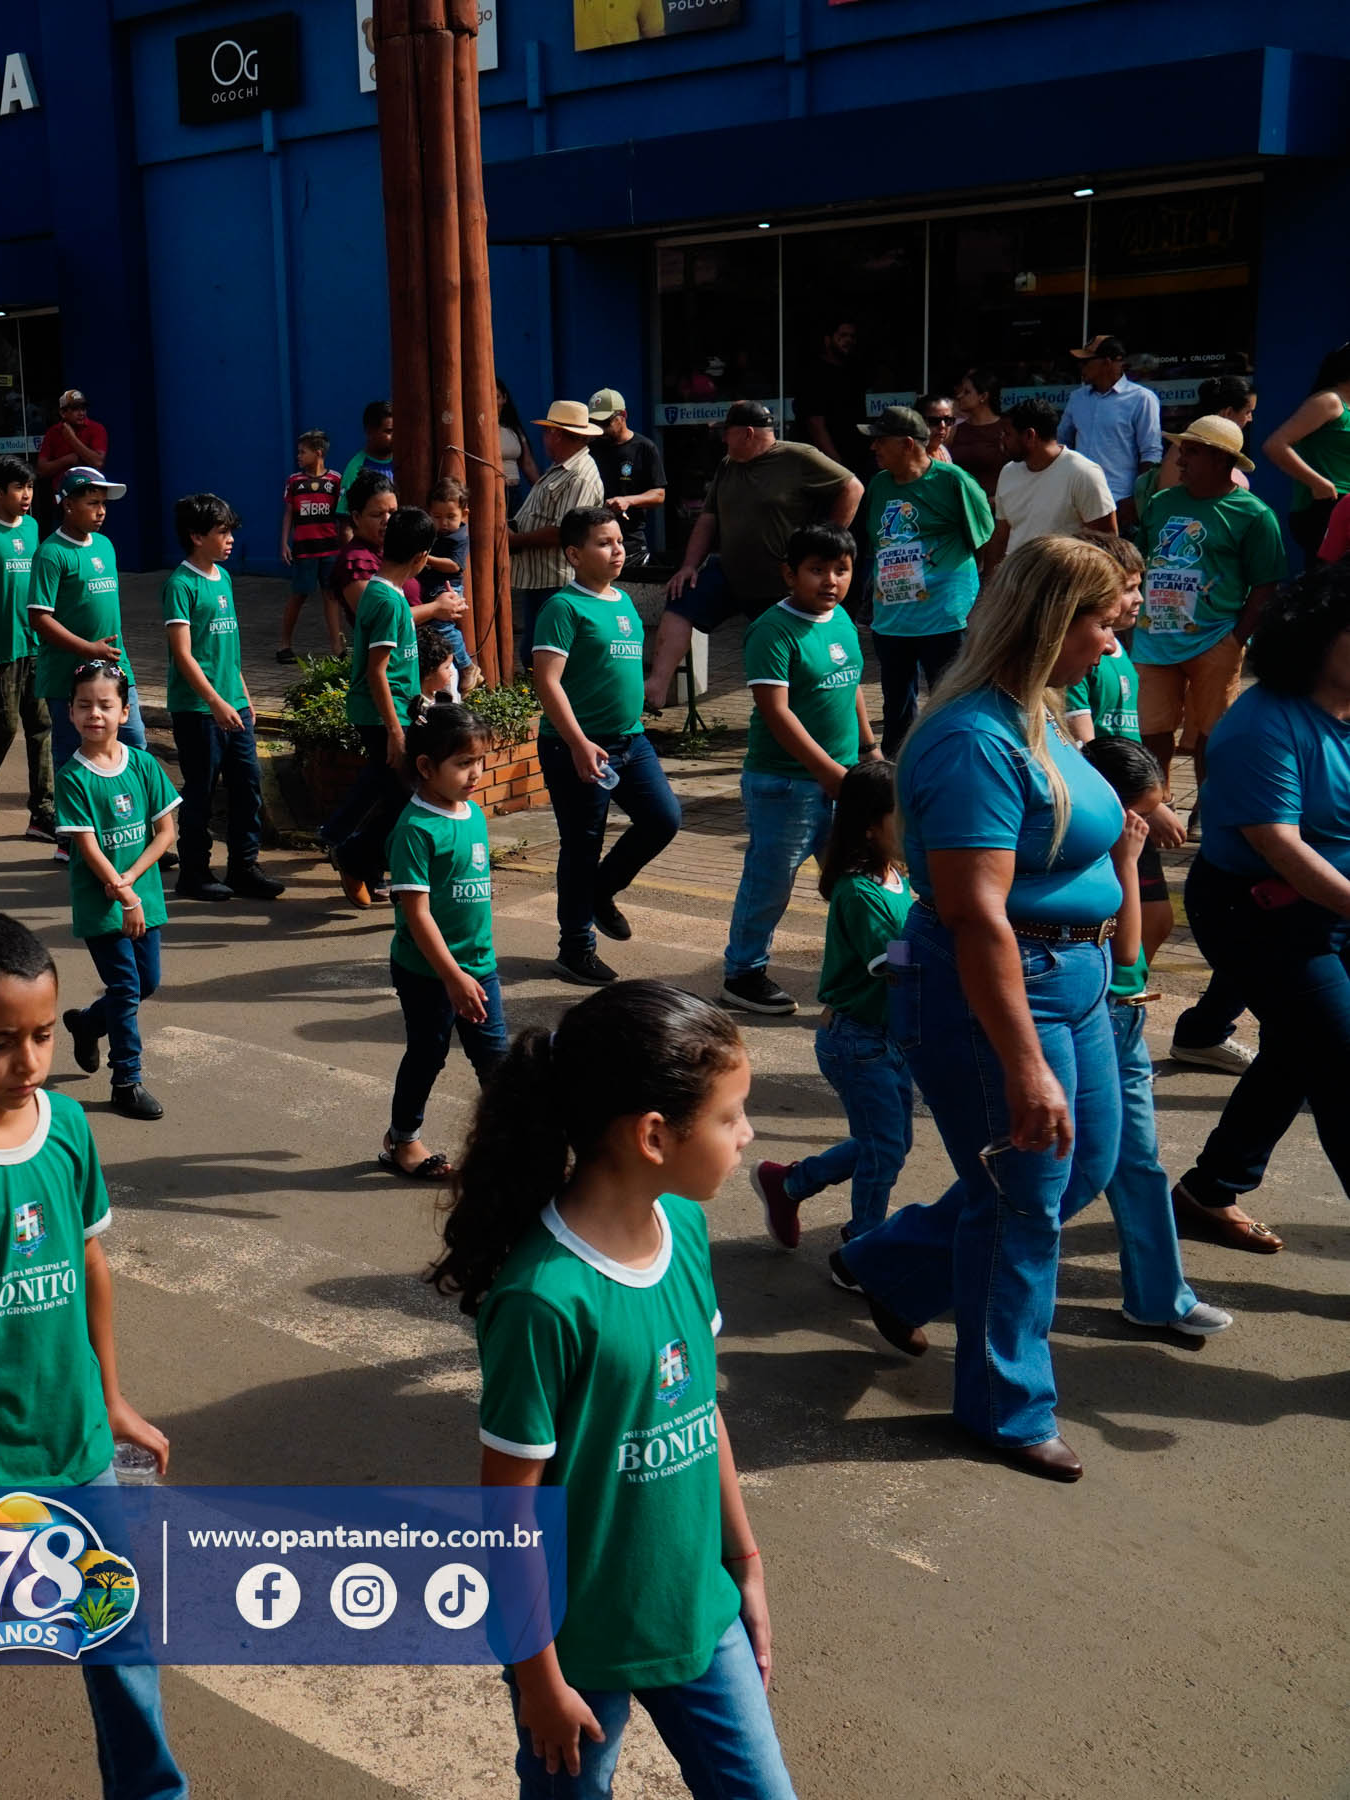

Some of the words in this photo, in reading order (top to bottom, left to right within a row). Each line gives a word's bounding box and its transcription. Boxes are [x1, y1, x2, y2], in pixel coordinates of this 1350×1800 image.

[211, 86, 259, 104] OGOCHI
[24, 1263, 59, 1277] MUNICIPAL
[61, 1260, 70, 1268] DE
[7, 1303, 42, 1315] GROSSO
[44, 1301, 55, 1310] DO
[56, 1297, 69, 1306] SUL
[623, 1421, 673, 1441] PREFEITURA
[626, 1471, 658, 1483] MATO
[660, 1457, 692, 1477] GROSSO
[692, 1451, 704, 1462] DO
